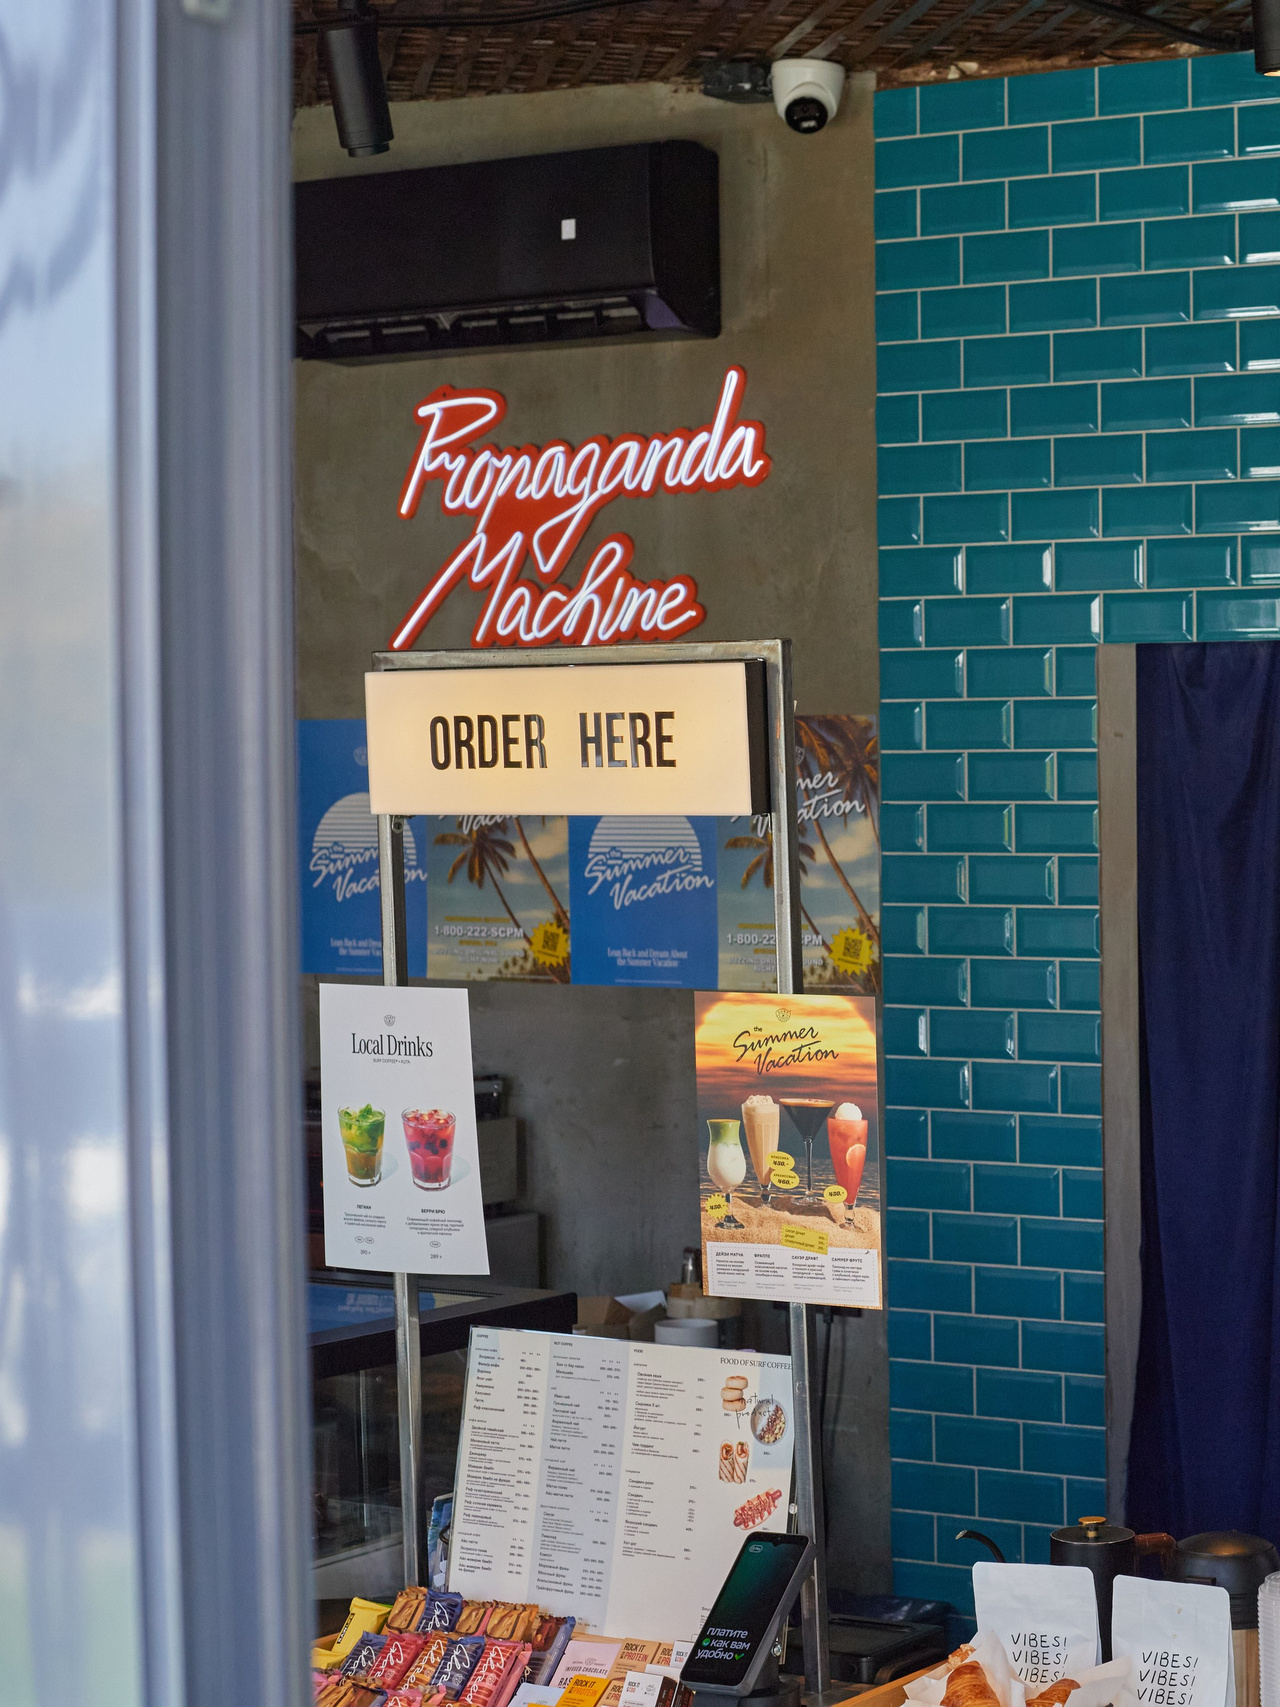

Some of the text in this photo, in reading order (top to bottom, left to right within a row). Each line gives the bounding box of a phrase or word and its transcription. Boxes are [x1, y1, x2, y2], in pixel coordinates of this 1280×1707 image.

[400, 369, 764, 573] Propaganda
[393, 531, 697, 646] Machine
[429, 710, 677, 771] ORDER HERE
[309, 848, 379, 888] Summ
[584, 847, 690, 895] Summer
[609, 864, 715, 910] Vacation
[434, 925, 524, 939] 1-800-222-SCPM
[357, 937, 368, 947] and
[338, 947, 347, 956] the
[607, 947, 688, 958] Lean Back and Dream About
[616, 957, 679, 967] the Summer Vacation
[351, 1032, 433, 1058] Local Drinks
[733, 1026, 819, 1063] Summer
[753, 1040, 839, 1075] Vacation
[720, 1357, 739, 1366] FOOD
[749, 1360, 767, 1368] SURF
[741, 1393, 774, 1405] natural
[706, 1627, 749, 1639] платите
[623, 1642, 646, 1652] ROCK IT
[710, 1639, 751, 1650] как вам
[1011, 1632, 1067, 1651] VIBES!
[623, 1651, 649, 1663] PROTEIN
[695, 1648, 734, 1660] удобно
[1012, 1650, 1069, 1669] VIBES!
[1142, 1651, 1199, 1672] VIBES!
[464, 1645, 505, 1705] Glazed
[582, 1667, 609, 1676] CHOCOLATE
[1139, 1669, 1196, 1690] VIBES!
[572, 1678, 596, 1688] ROCK IT
[572, 1686, 598, 1697] PROTEIN
[1137, 1687, 1193, 1706] VIBES!
